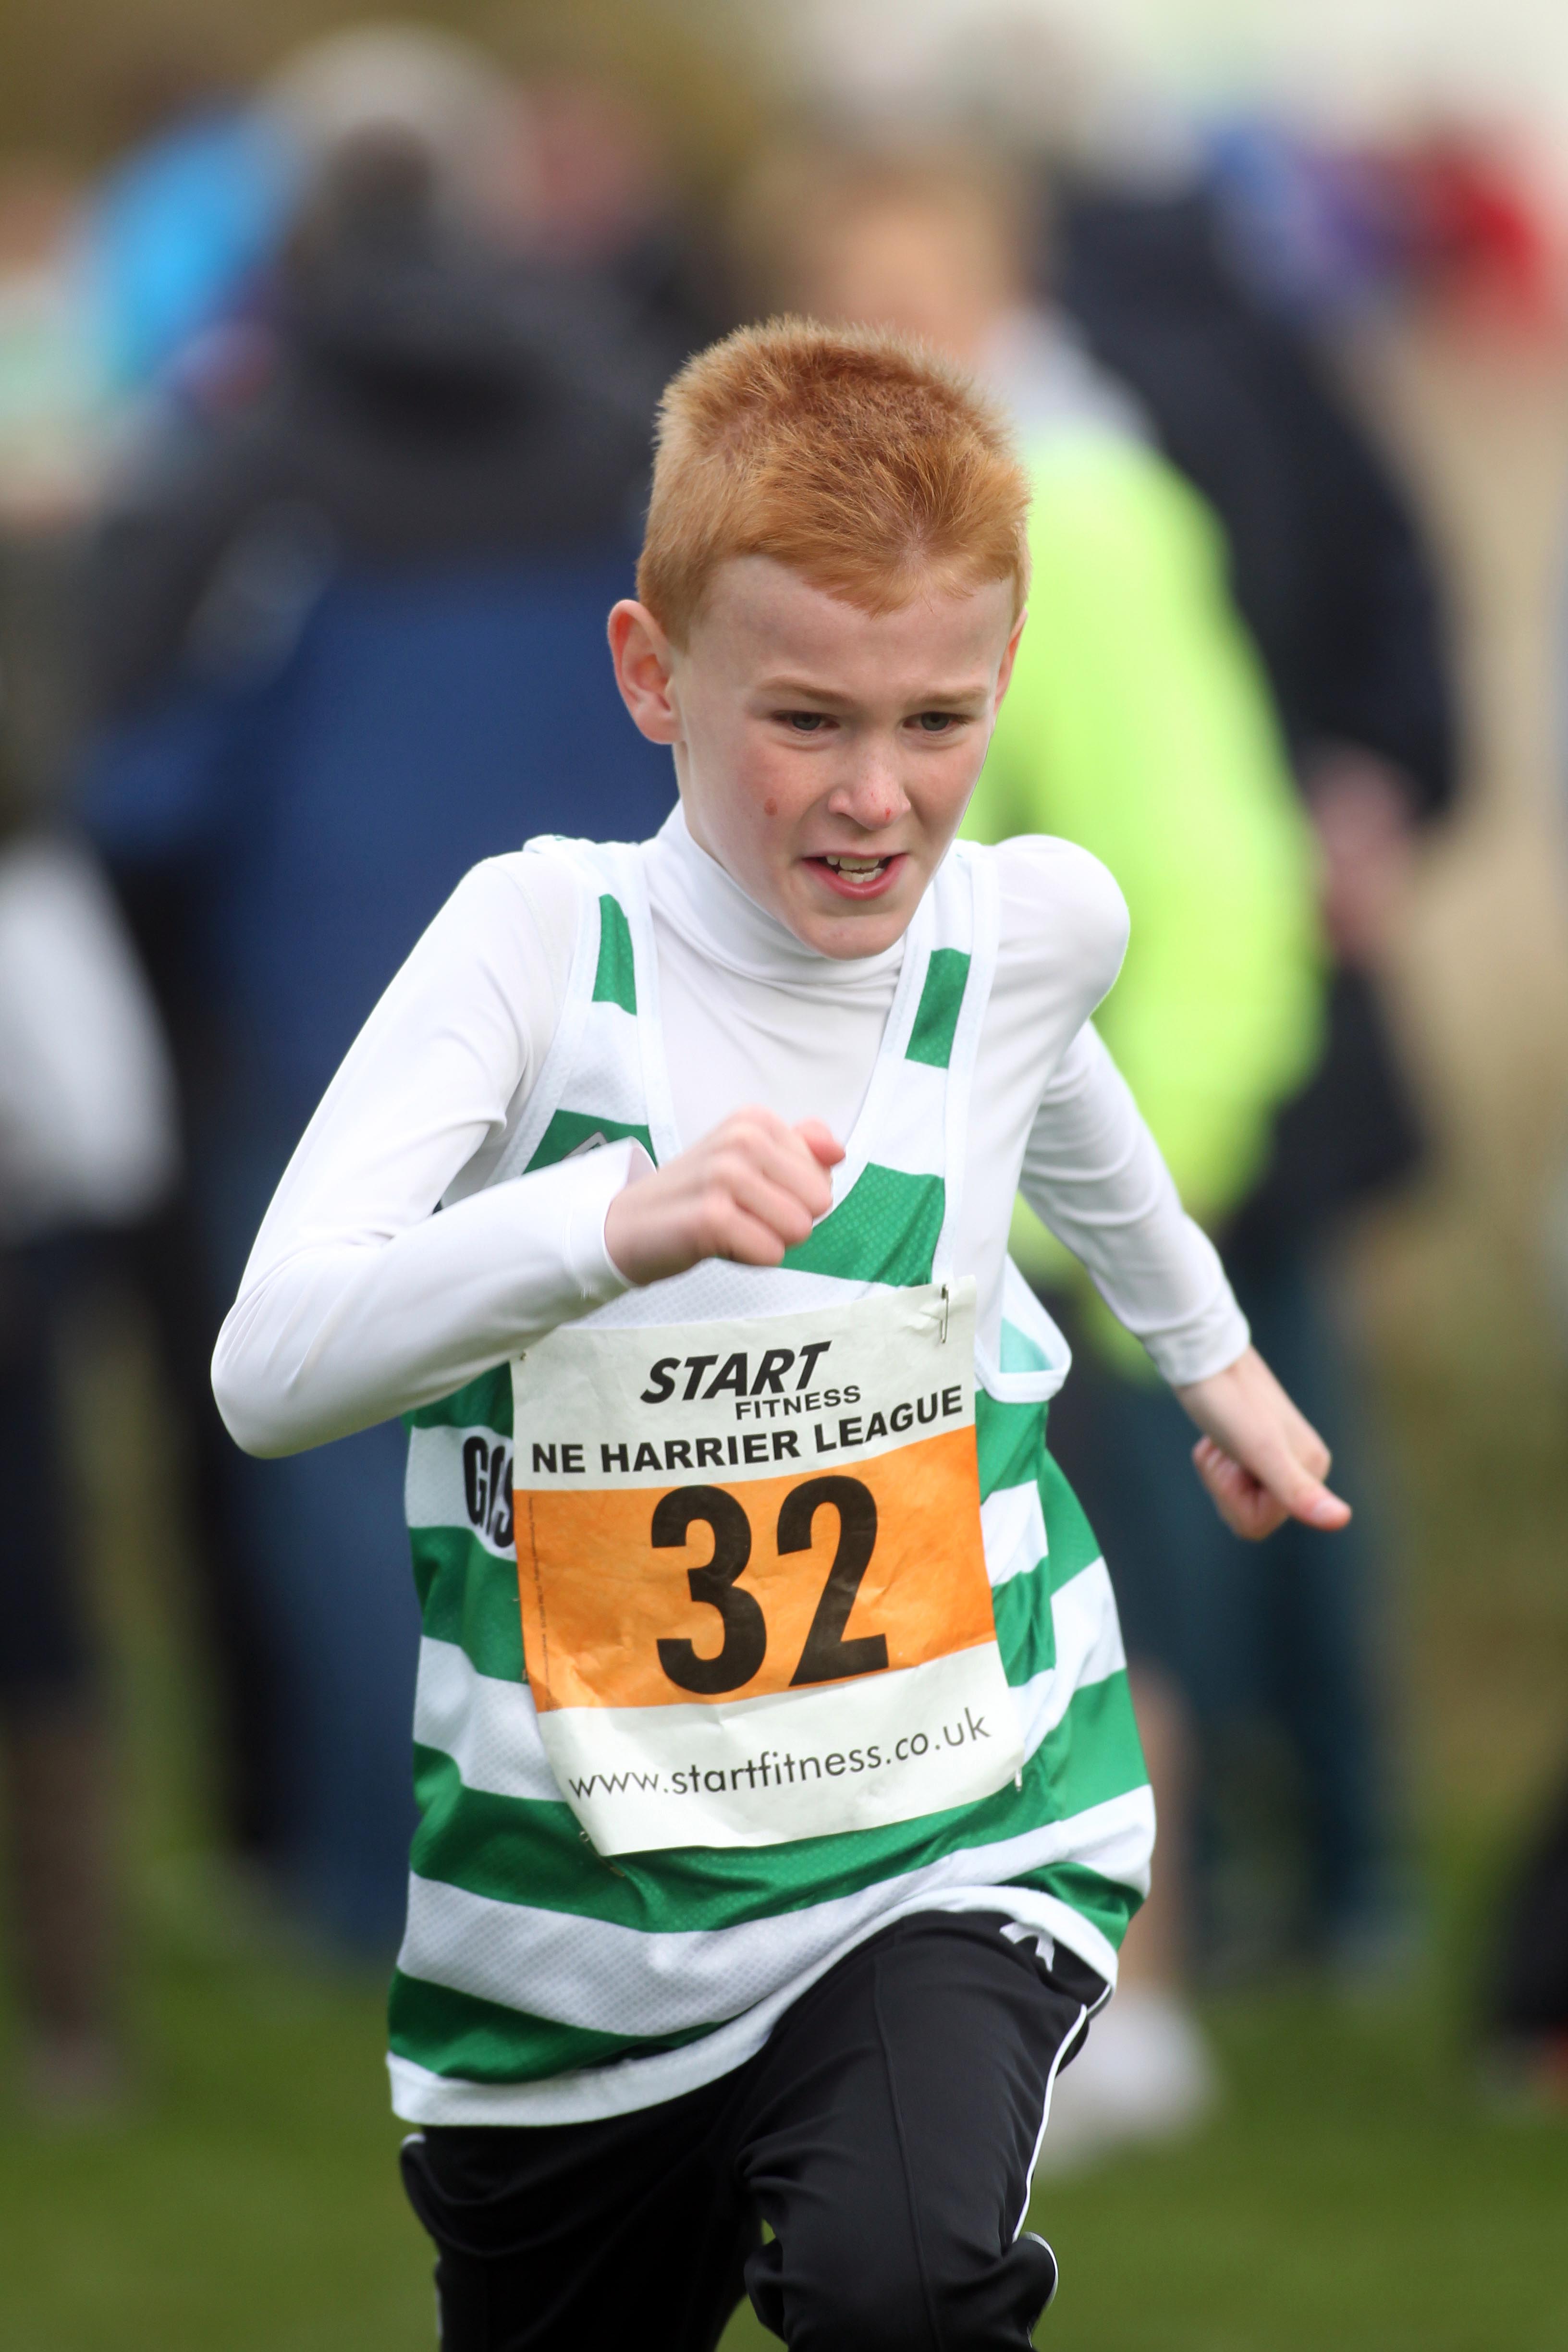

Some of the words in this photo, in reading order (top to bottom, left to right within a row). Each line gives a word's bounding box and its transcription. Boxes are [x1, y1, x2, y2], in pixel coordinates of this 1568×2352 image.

[640, 1340, 832, 1404] START
[735, 1385, 861, 1421] FITNESS
[532, 1443, 586, 1473] NE
[600, 1430, 801, 1473] HARRIER
[814, 1385, 963, 1453] LEAGUE
[650, 1475, 889, 1695] 32
[569, 1707, 992, 1800] www.startfitness.co.uk
